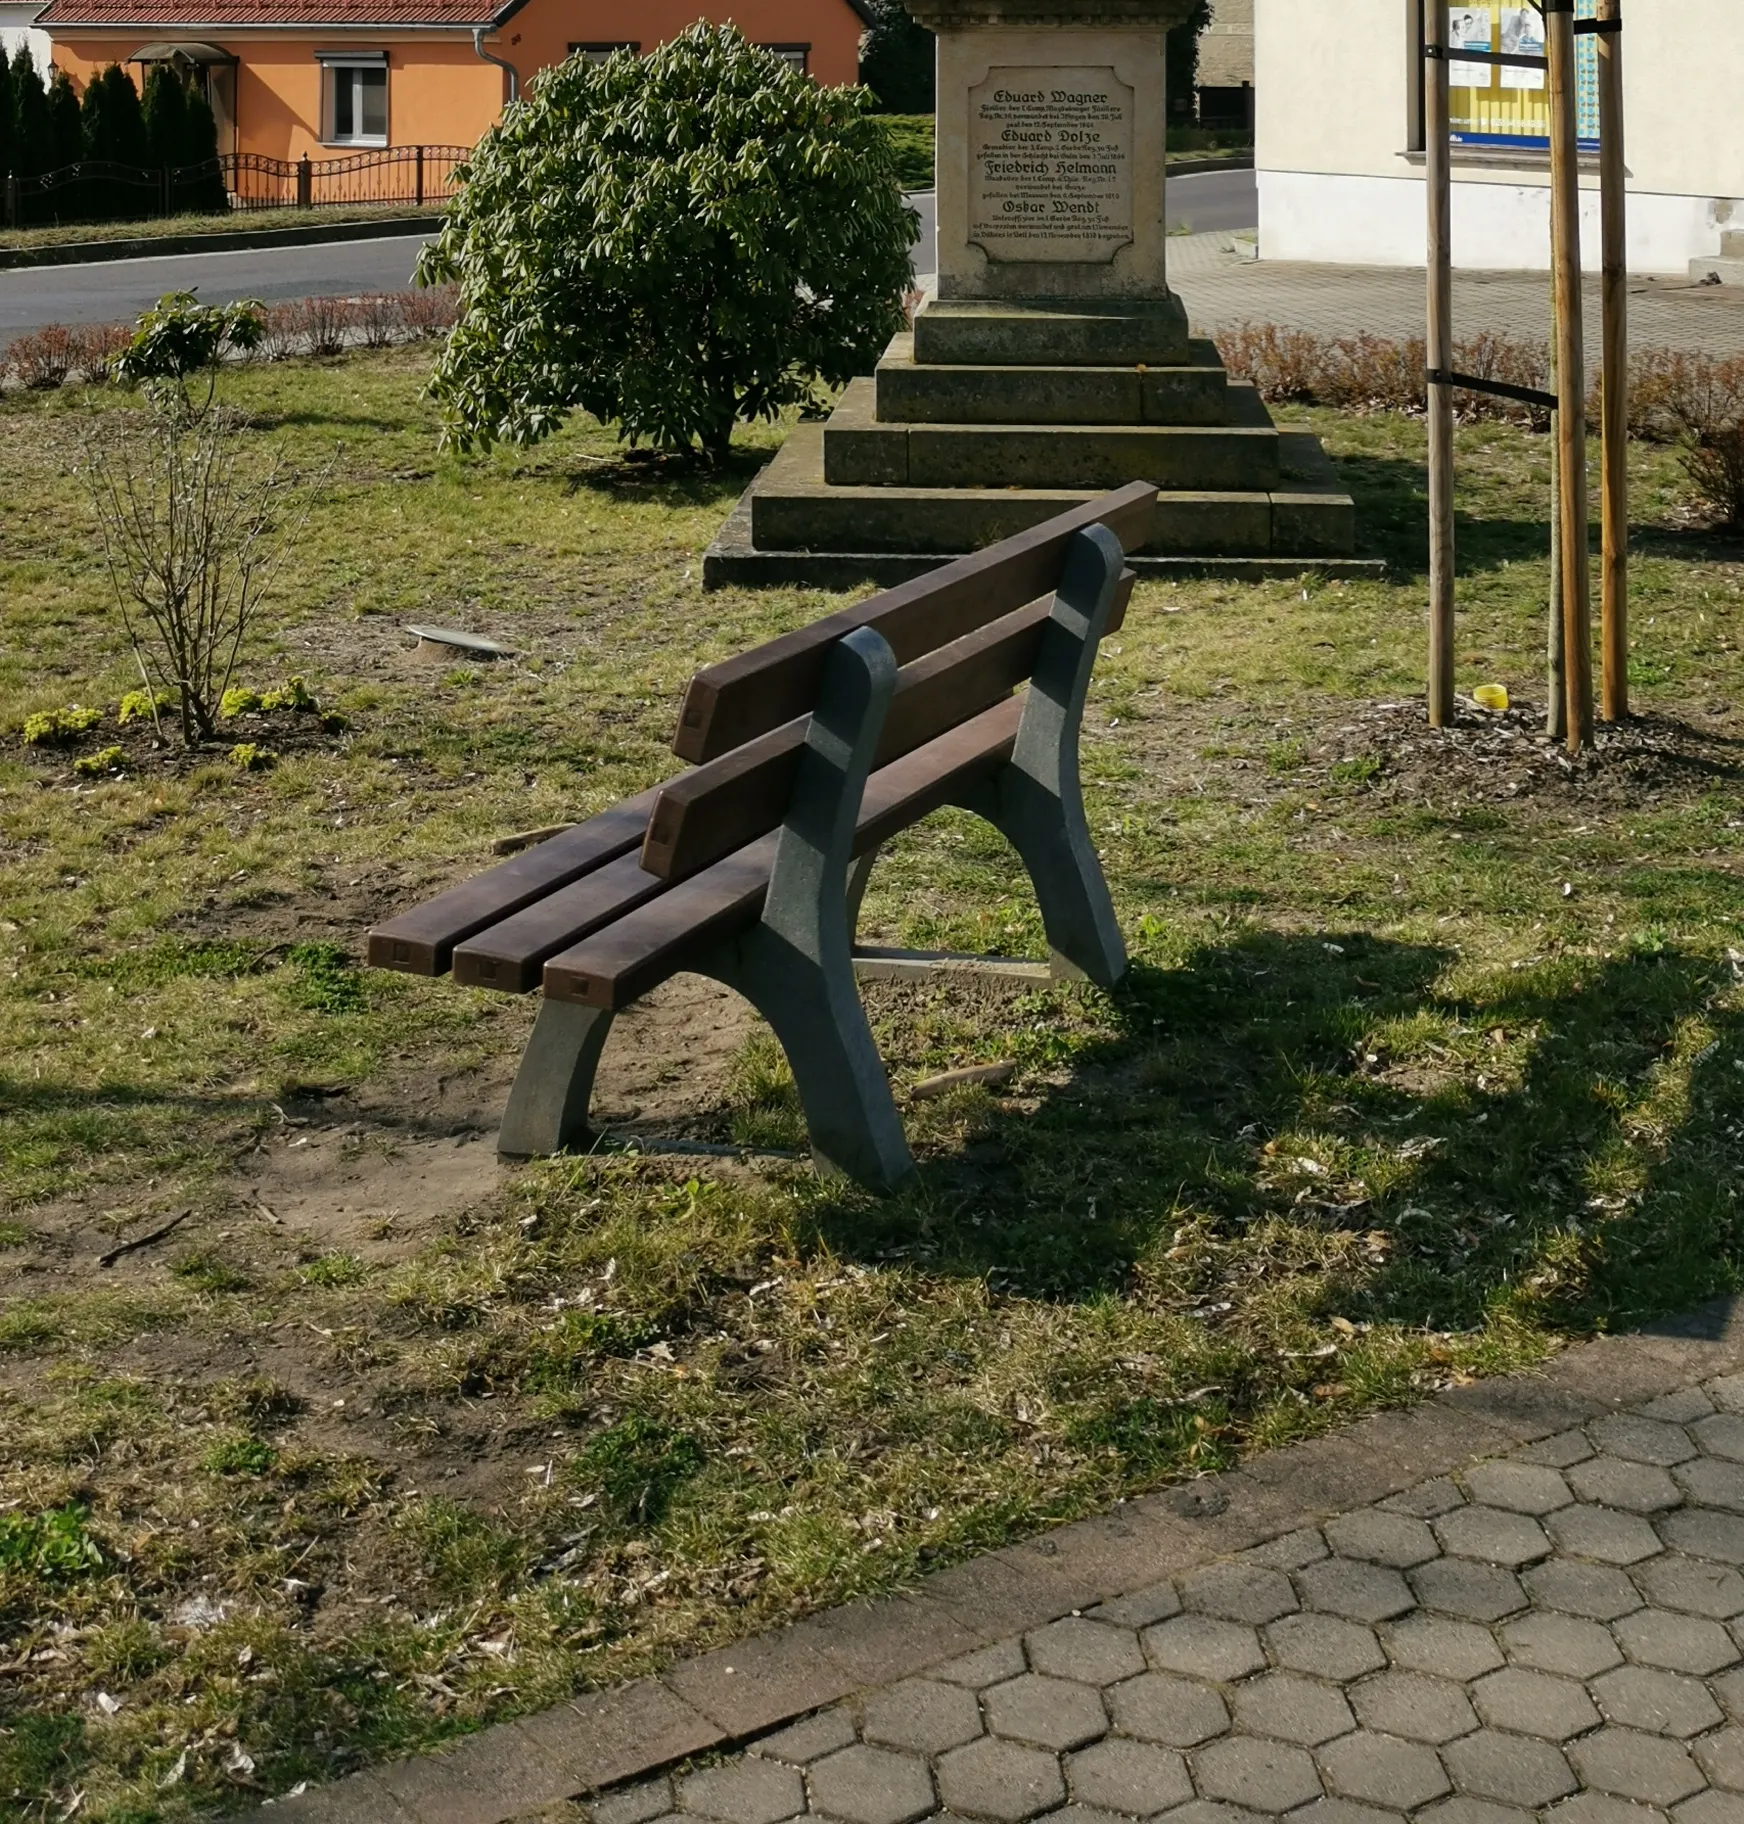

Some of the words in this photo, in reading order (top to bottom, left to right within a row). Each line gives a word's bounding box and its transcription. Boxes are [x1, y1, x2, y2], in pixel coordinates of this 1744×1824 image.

[994, 90, 1045, 103] Eduard
[1051, 90, 1108, 106] Wagner
[1001, 129, 1052, 142] Eduard
[1058, 130, 1100, 144] Dolze
[984, 160, 1049, 176] Friedrich
[1055, 161, 1117, 176] Helmann
[1003, 200, 1045, 213] Oskar
[1052, 200, 1100, 214] Wendt
